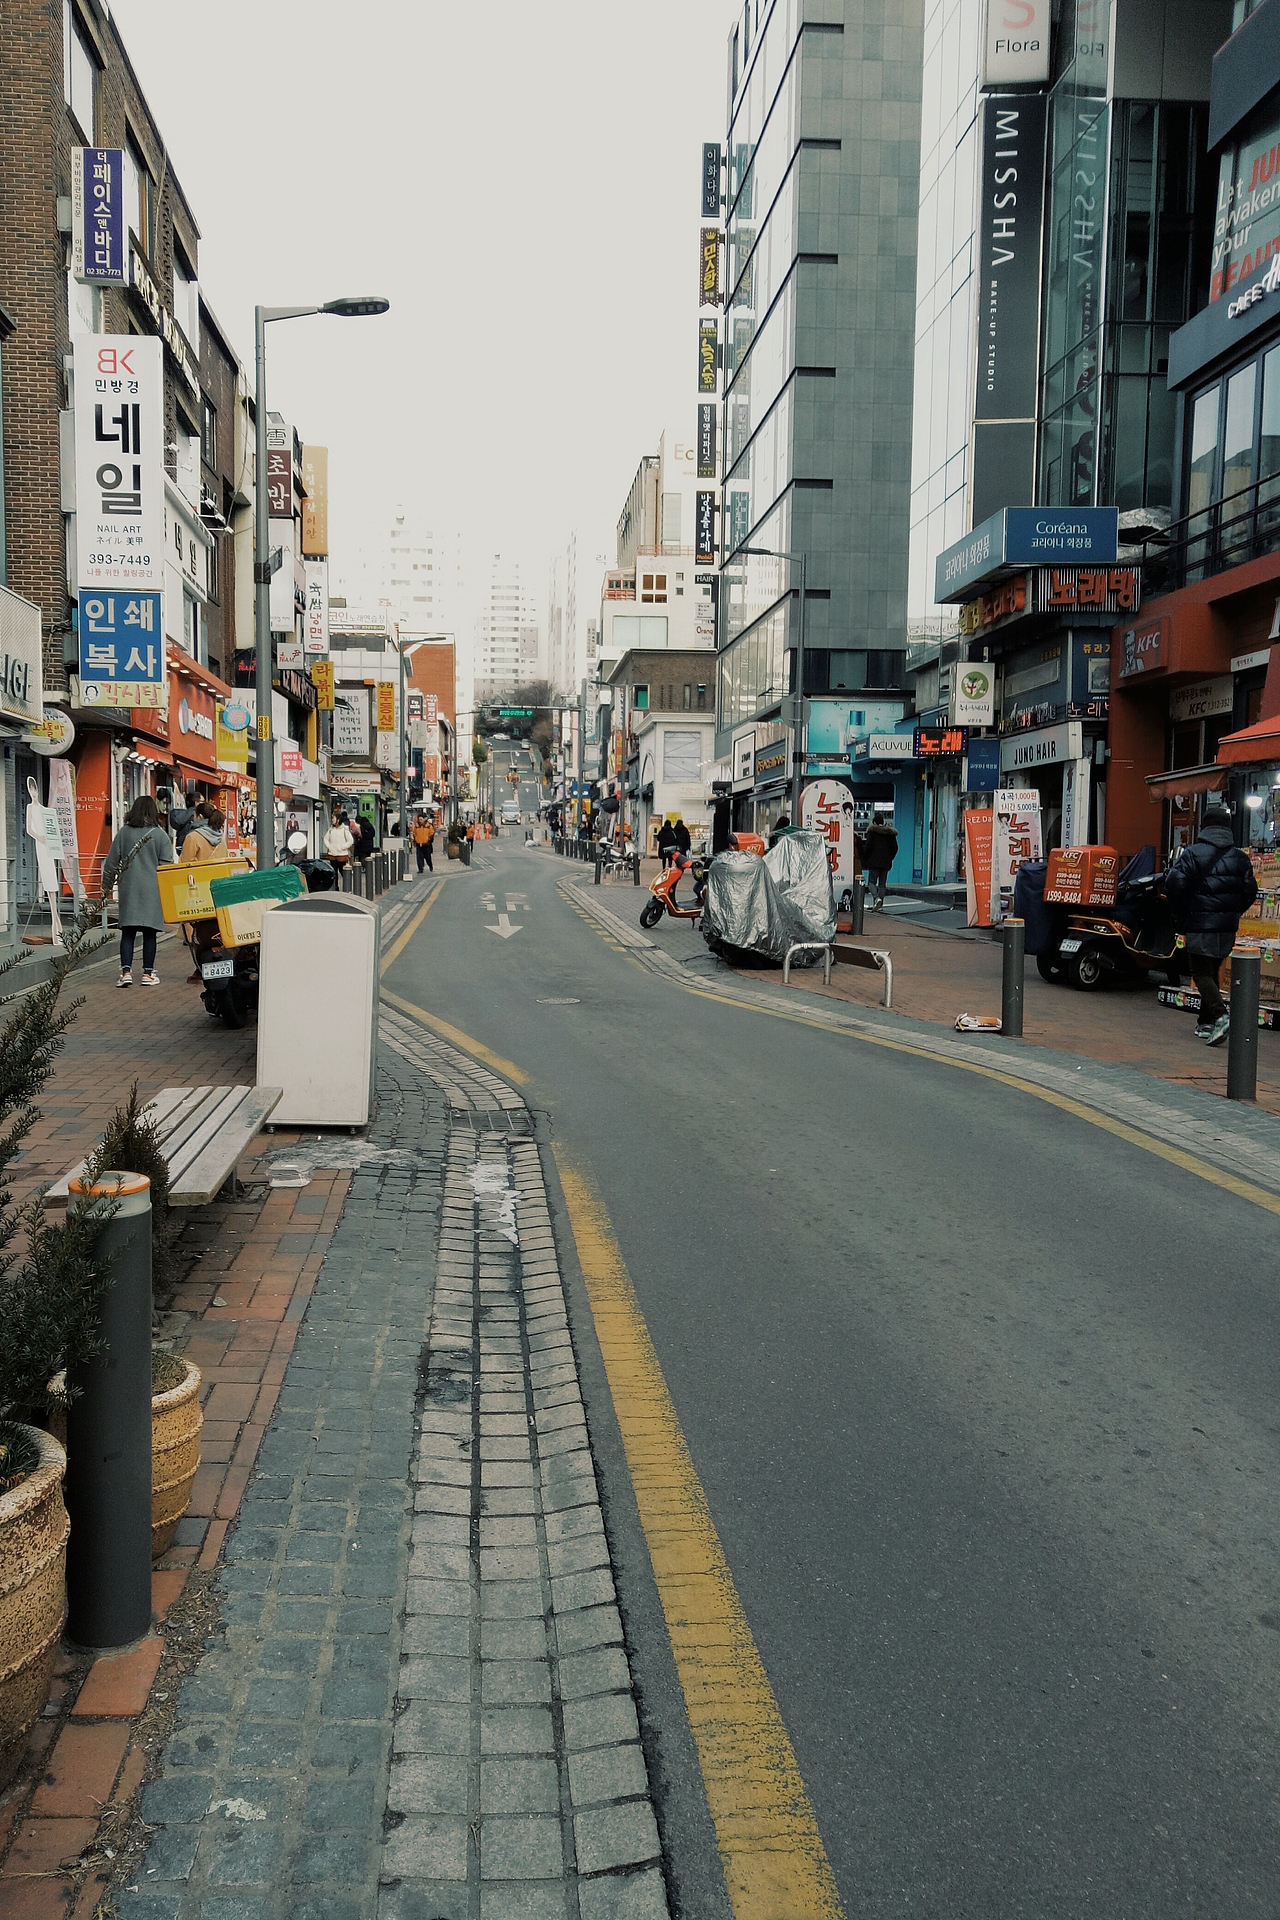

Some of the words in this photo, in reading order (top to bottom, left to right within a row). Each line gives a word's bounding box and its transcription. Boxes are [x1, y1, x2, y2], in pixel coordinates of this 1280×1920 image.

[995, 39, 1040, 53] Flora
[706, 149, 717, 208] 이화다방
[991, 110, 1020, 267] MISSHA
[1218, 177, 1244, 211] Let
[1213, 223, 1252, 268] your
[990, 280, 998, 337] MAKE-UP
[1227, 282, 1263, 319] CAFE
[987, 344, 996, 391] STUDIO
[94, 403, 142, 515] 네일
[97, 525, 118, 533] NAIL
[122, 525, 142, 533] ART
[1036, 521, 1088, 534] Coréana
[1031, 537, 1064, 548] 코리아나
[1066, 537, 1092, 548] 화장품
[88, 554, 151, 565] 393-7449
[1048, 570, 1138, 608] 노래방
[85, 598, 154, 632] 인쇄
[1136, 631, 1161, 653] KFC
[85, 644, 157, 678] 복사
[101, 683, 160, 705] 각시탈
[1188, 701, 1207, 716] KFC
[871, 741, 912, 751] ACUVUE
[1014, 745, 1034, 765] JUNO
[1036, 740, 1057, 761] HAIR
[1099, 858, 1112, 866] KFC
[1047, 891, 1082, 904] 1599-8484
[210, 967, 231, 976] 8423
